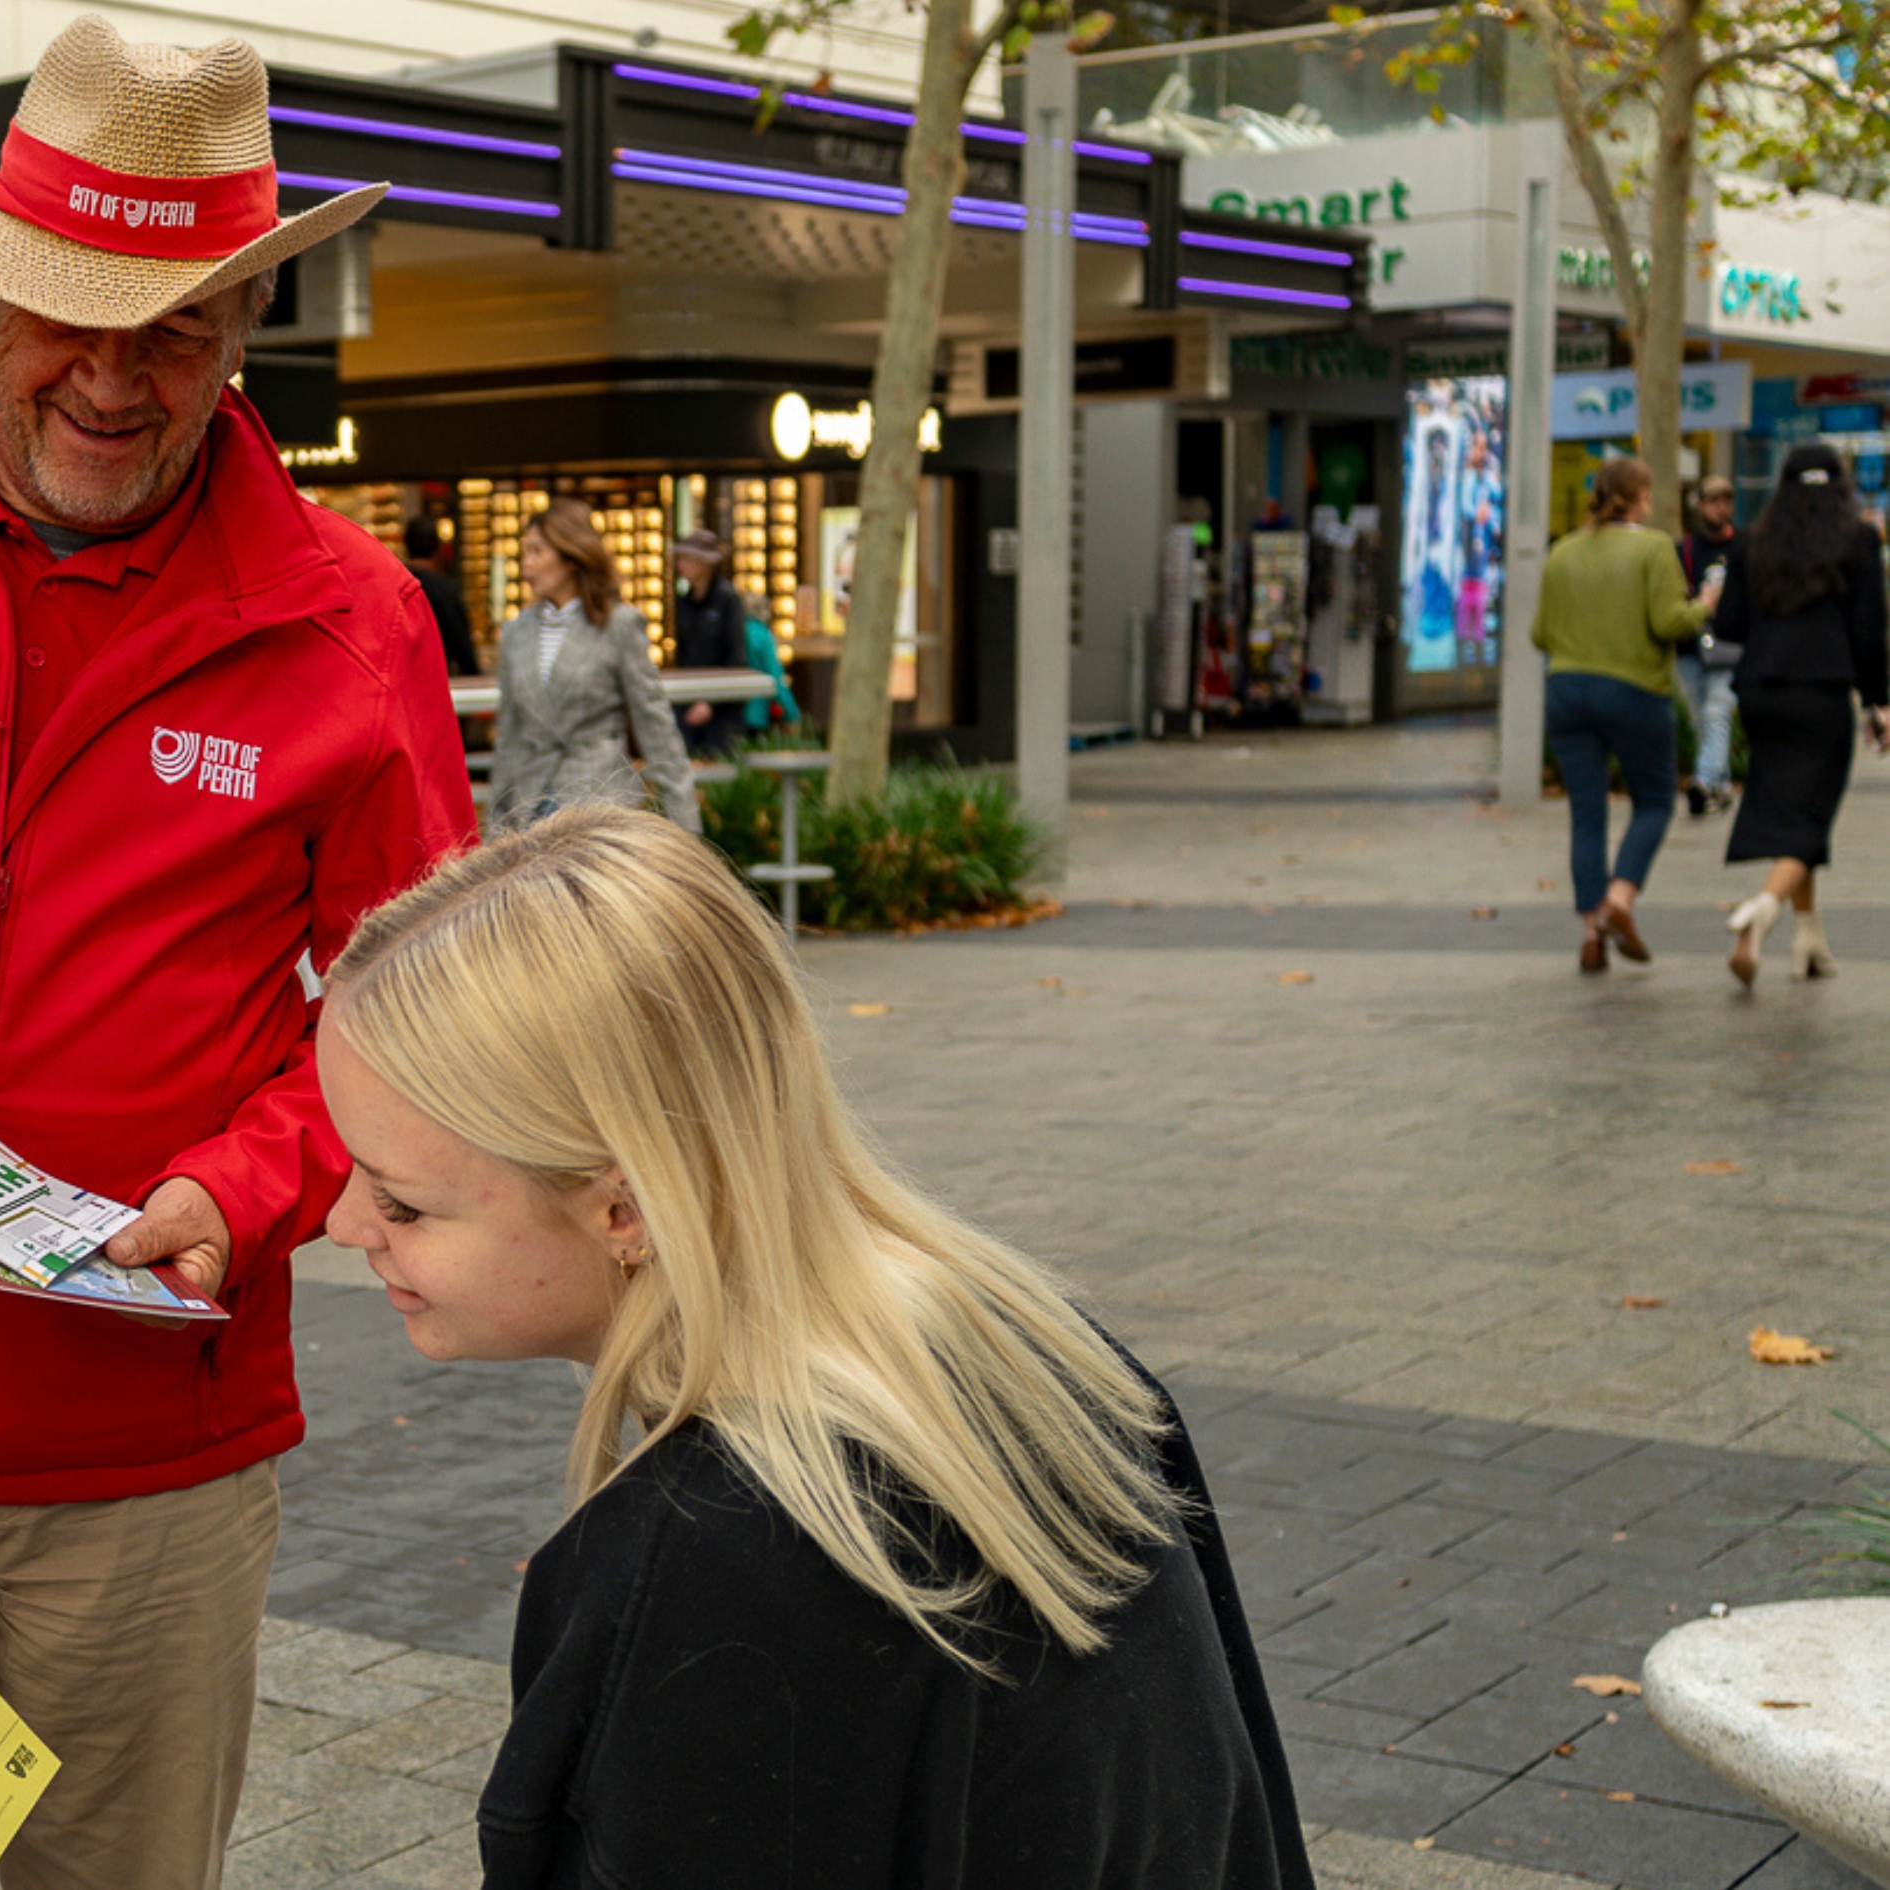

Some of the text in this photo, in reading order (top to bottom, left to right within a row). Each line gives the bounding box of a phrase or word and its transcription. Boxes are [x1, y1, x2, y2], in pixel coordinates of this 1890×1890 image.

[69, 184, 196, 227] CITY OF PERTH
[1722, 264, 1800, 321] OPTUS
[203, 735, 262, 770] CITY OF
[198, 761, 256, 799] PERTH
